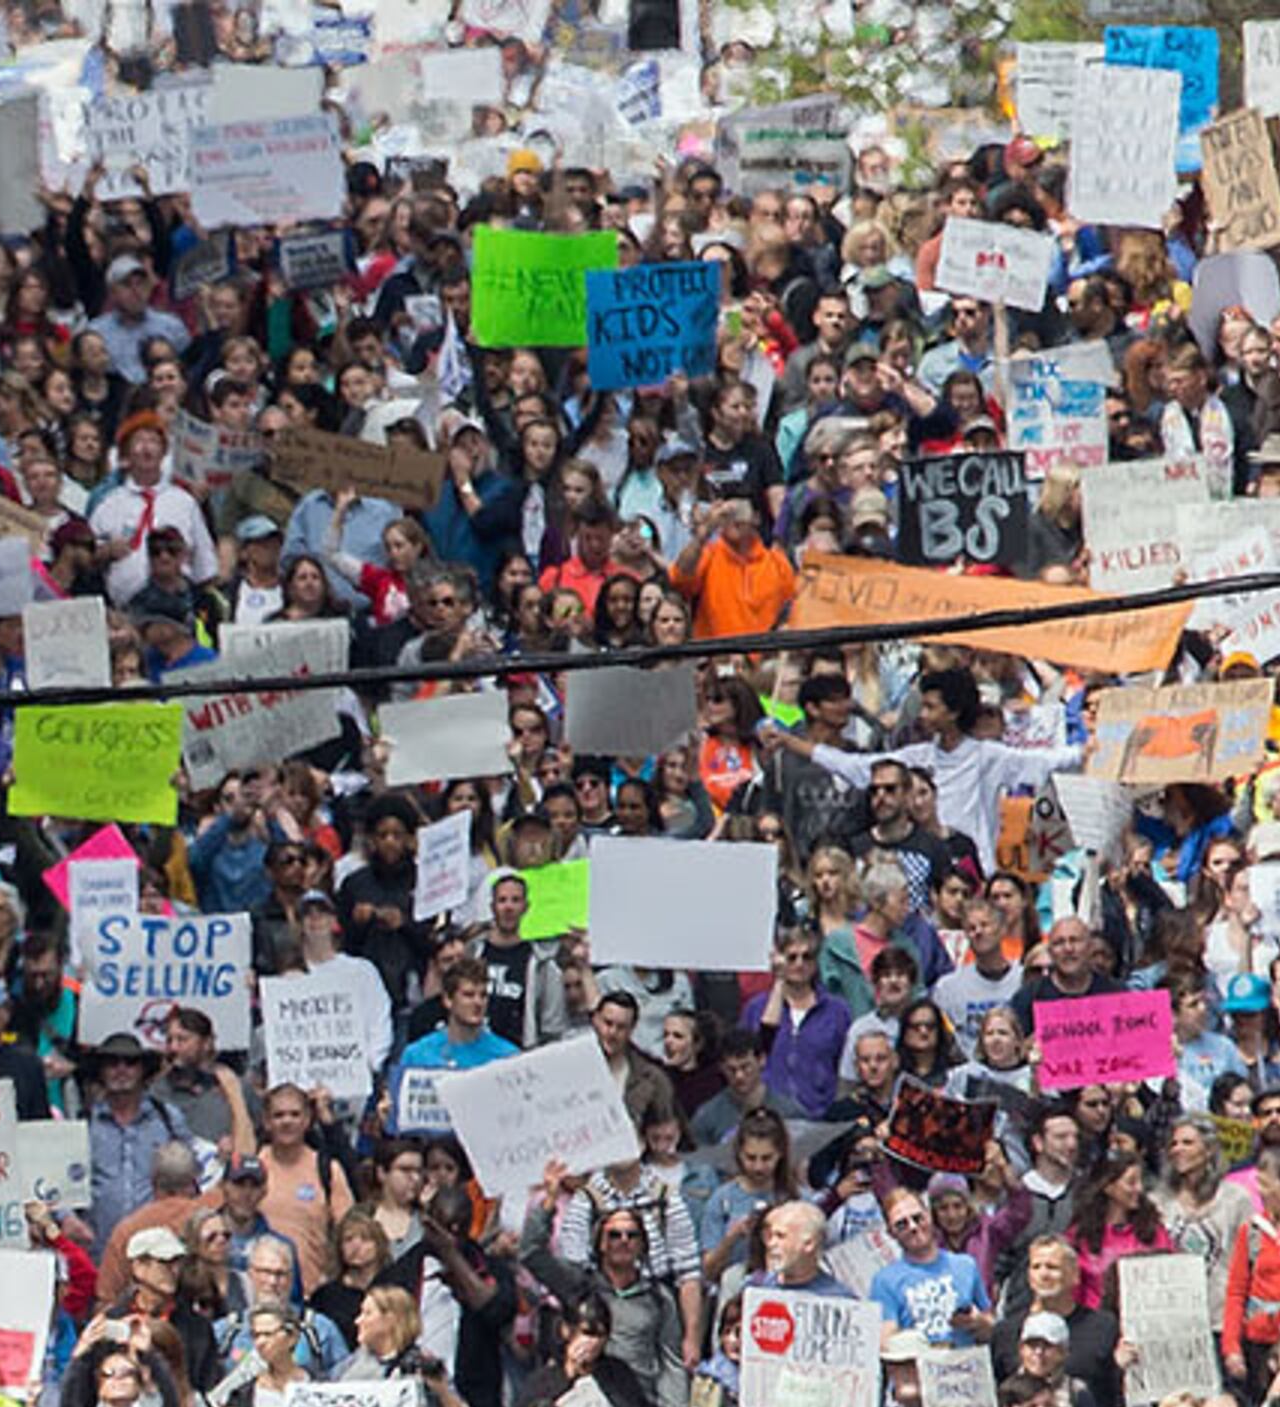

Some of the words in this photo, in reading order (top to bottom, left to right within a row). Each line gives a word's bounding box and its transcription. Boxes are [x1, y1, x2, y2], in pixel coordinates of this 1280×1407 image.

[593, 306, 681, 342] KIDS
[922, 498, 1009, 560] BS
[98, 916, 232, 956] STOP
[97, 963, 236, 997] SELLING
